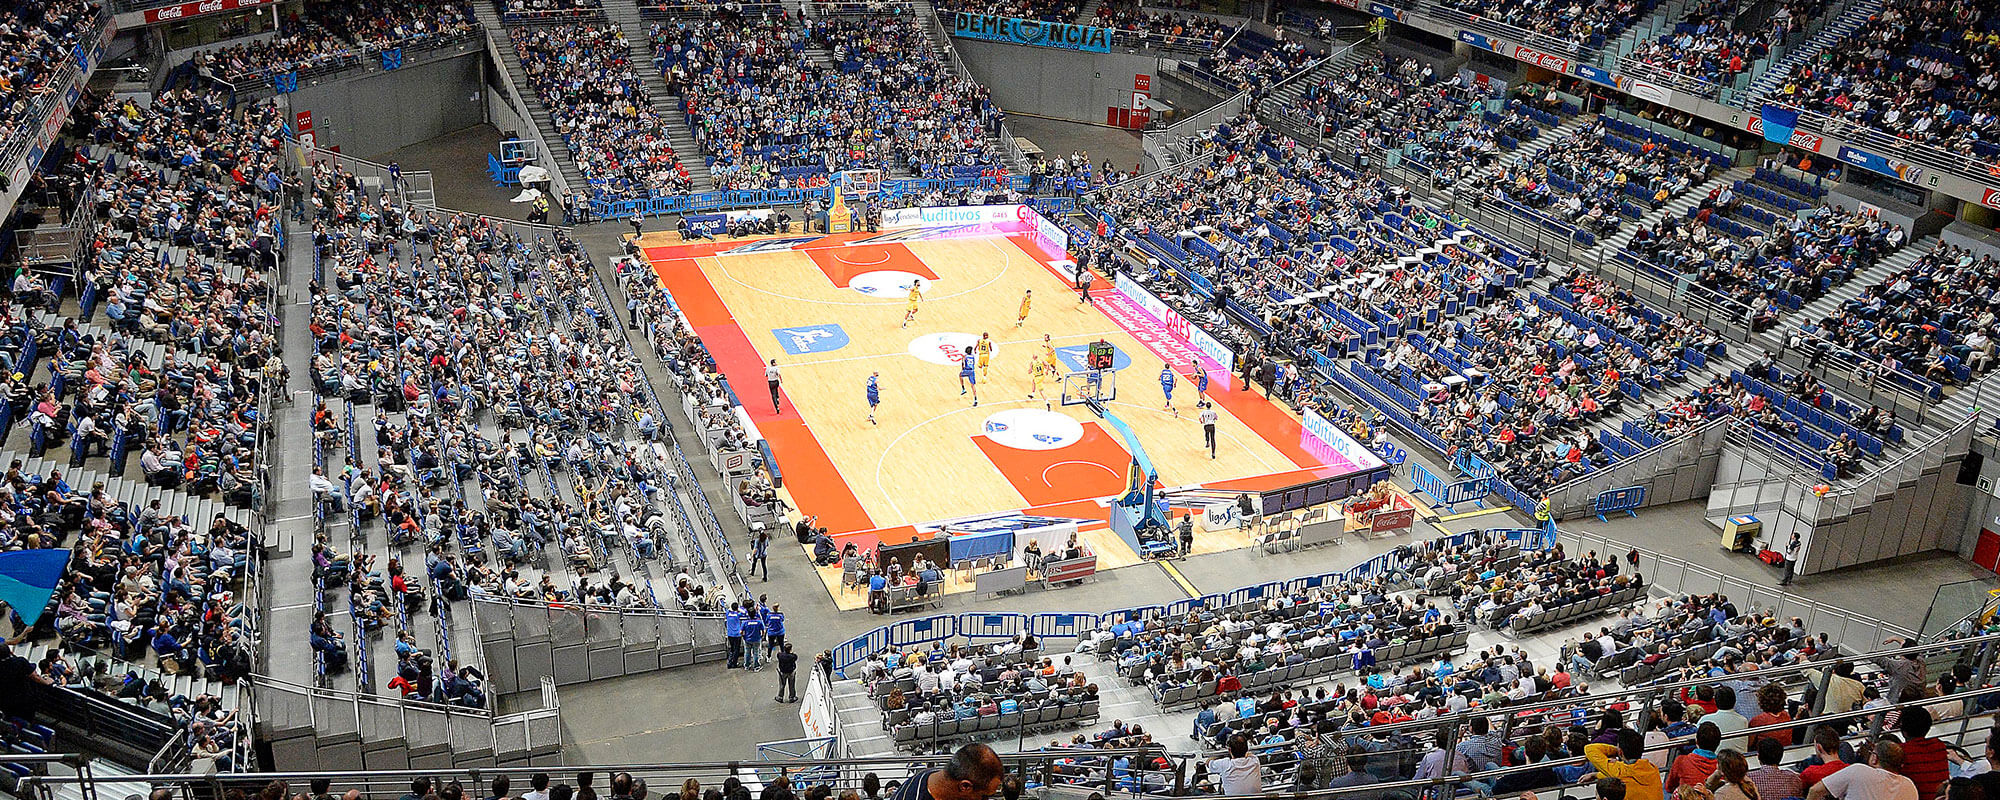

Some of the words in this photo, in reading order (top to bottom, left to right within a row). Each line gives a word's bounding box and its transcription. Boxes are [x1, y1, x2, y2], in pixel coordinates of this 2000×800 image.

[158, 7, 182, 20] Coca-Cola
[199, 1, 222, 13] Coca-Cola
[1517, 48, 1540, 63] Coca-Cola
[1541, 56, 1565, 70] Coca-Cola
[300, 134, 314, 151] B
[1017, 205, 1038, 228] GAES
[1041, 219, 1063, 246] Centros
[1166, 308, 1191, 340] GAES
[1195, 330, 1226, 365] Centros
[1098, 355, 1111, 367] 24
